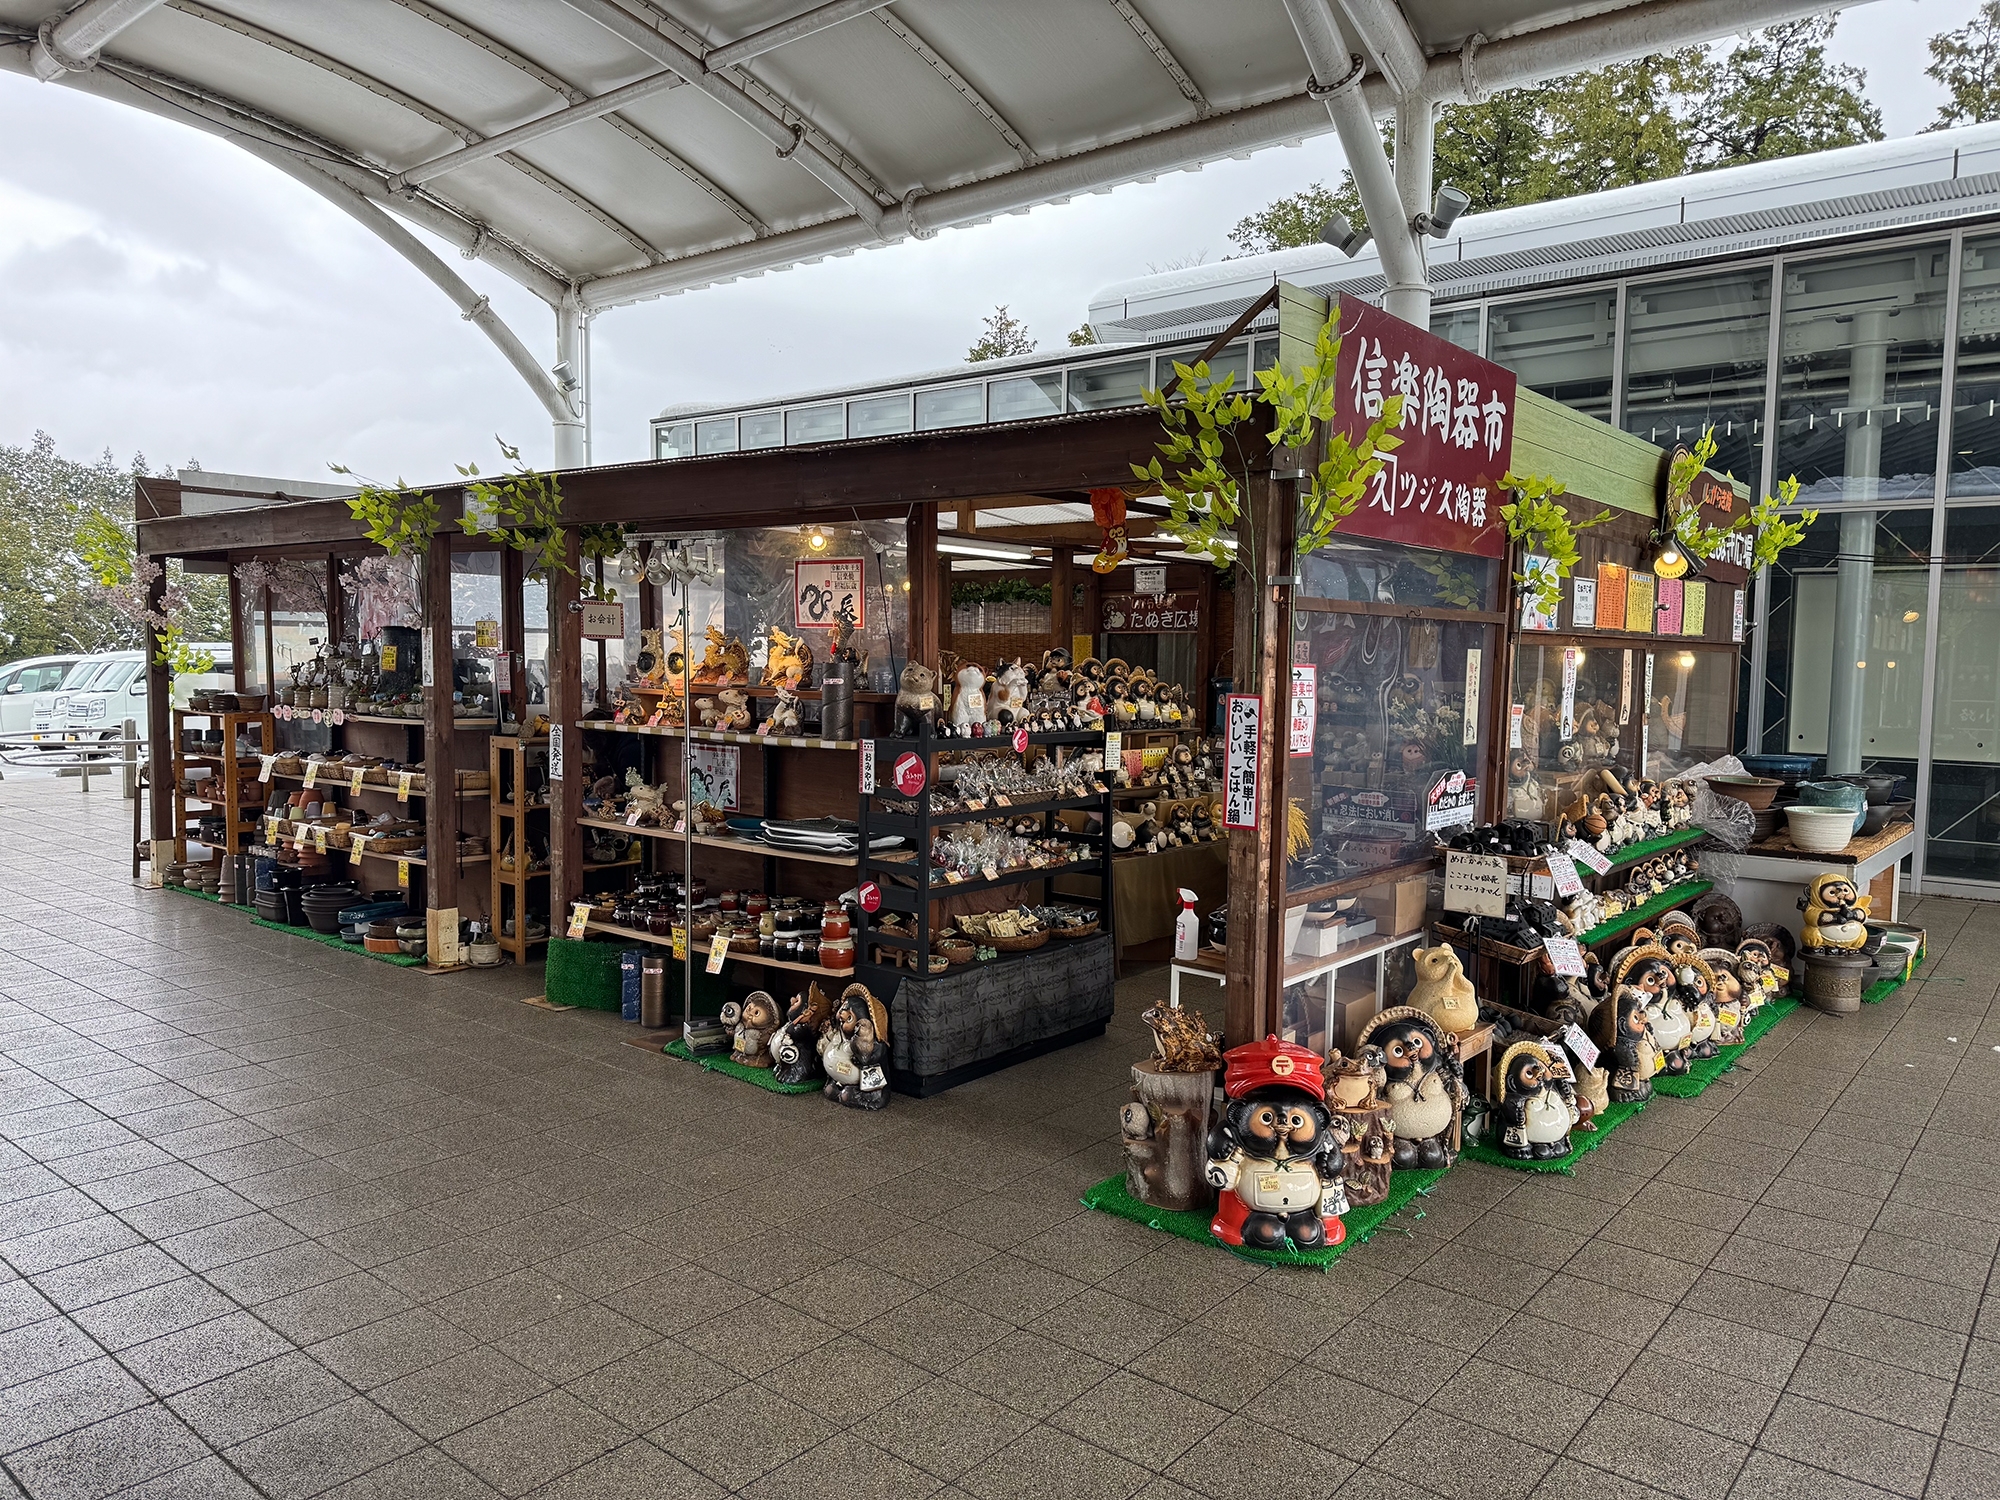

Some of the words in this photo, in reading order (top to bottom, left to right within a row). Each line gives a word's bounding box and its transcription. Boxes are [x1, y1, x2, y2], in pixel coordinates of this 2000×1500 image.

[1351, 336, 1507, 462] 信楽陶器市
[588, 613, 616, 626] お会計
[1130, 610, 1199, 629] たぬき広場
[1230, 699, 1244, 754] おいしい
[551, 724, 563, 777] 全国発送
[1340, 804, 1400, 822] 忍法におい消し
[1449, 871, 1500, 885] ここでしか販売
